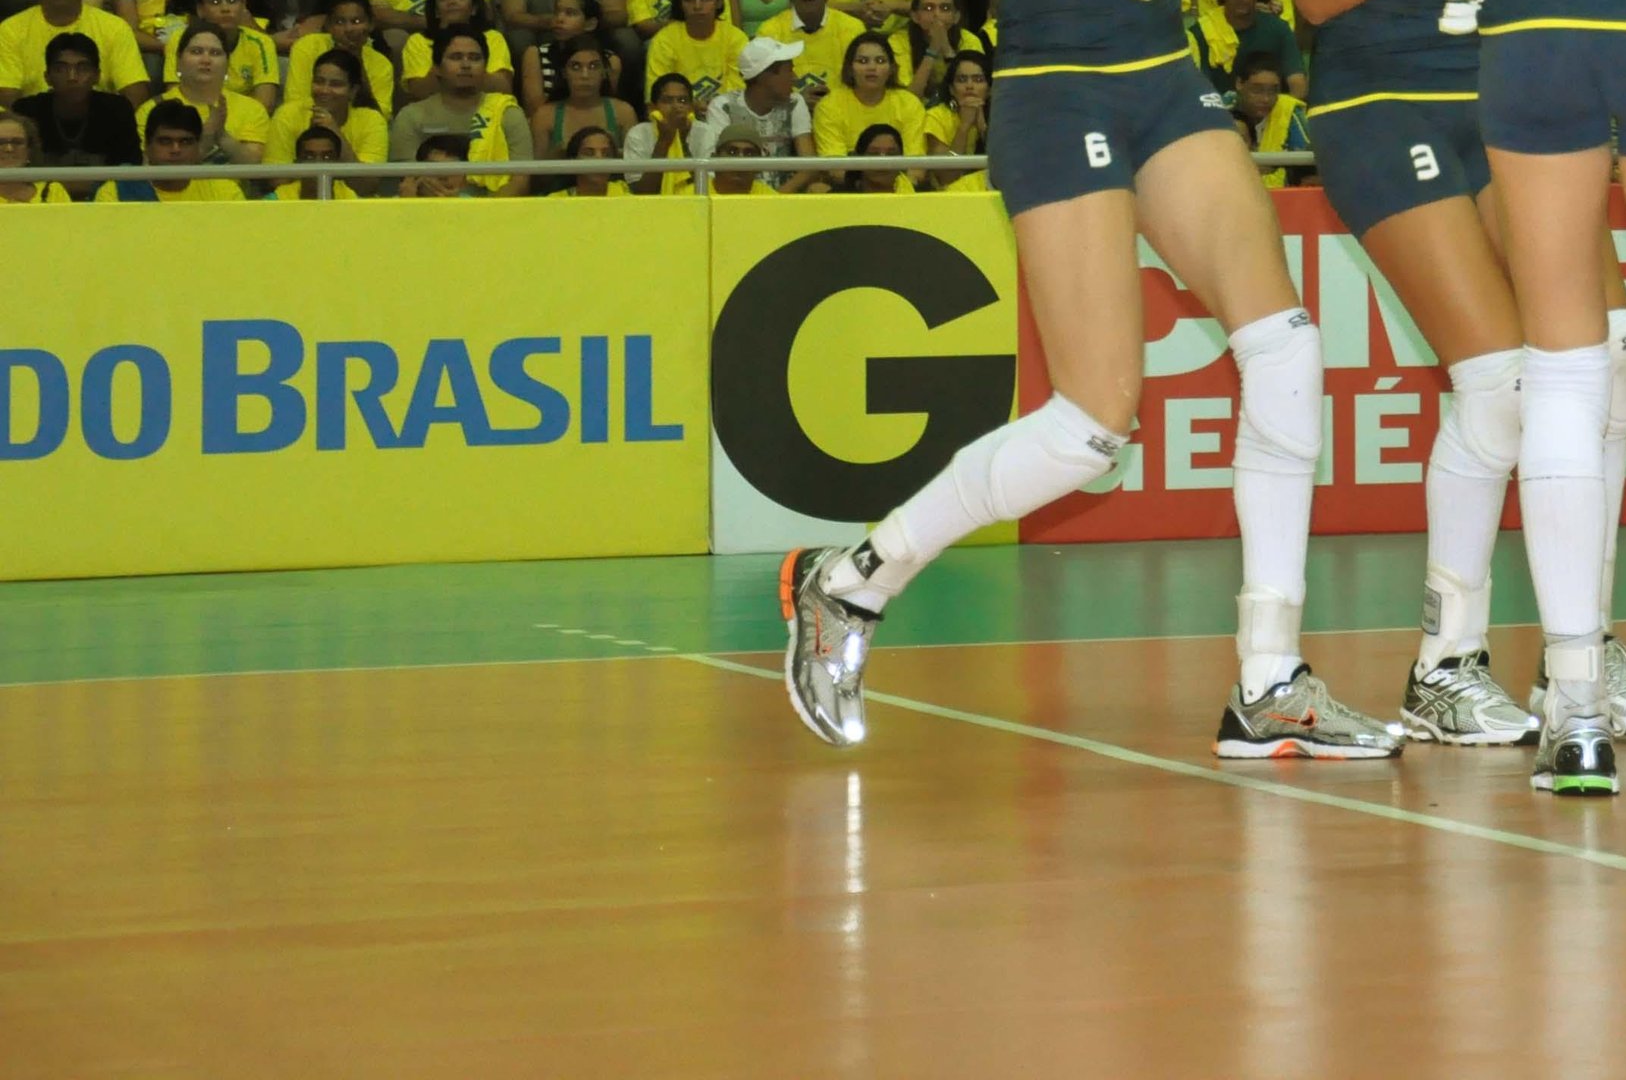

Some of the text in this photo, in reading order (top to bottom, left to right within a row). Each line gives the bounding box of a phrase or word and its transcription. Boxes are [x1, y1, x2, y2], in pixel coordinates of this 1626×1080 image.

[1085, 132, 1112, 168] 6
[0, 320, 684, 461] DO BRASIL
